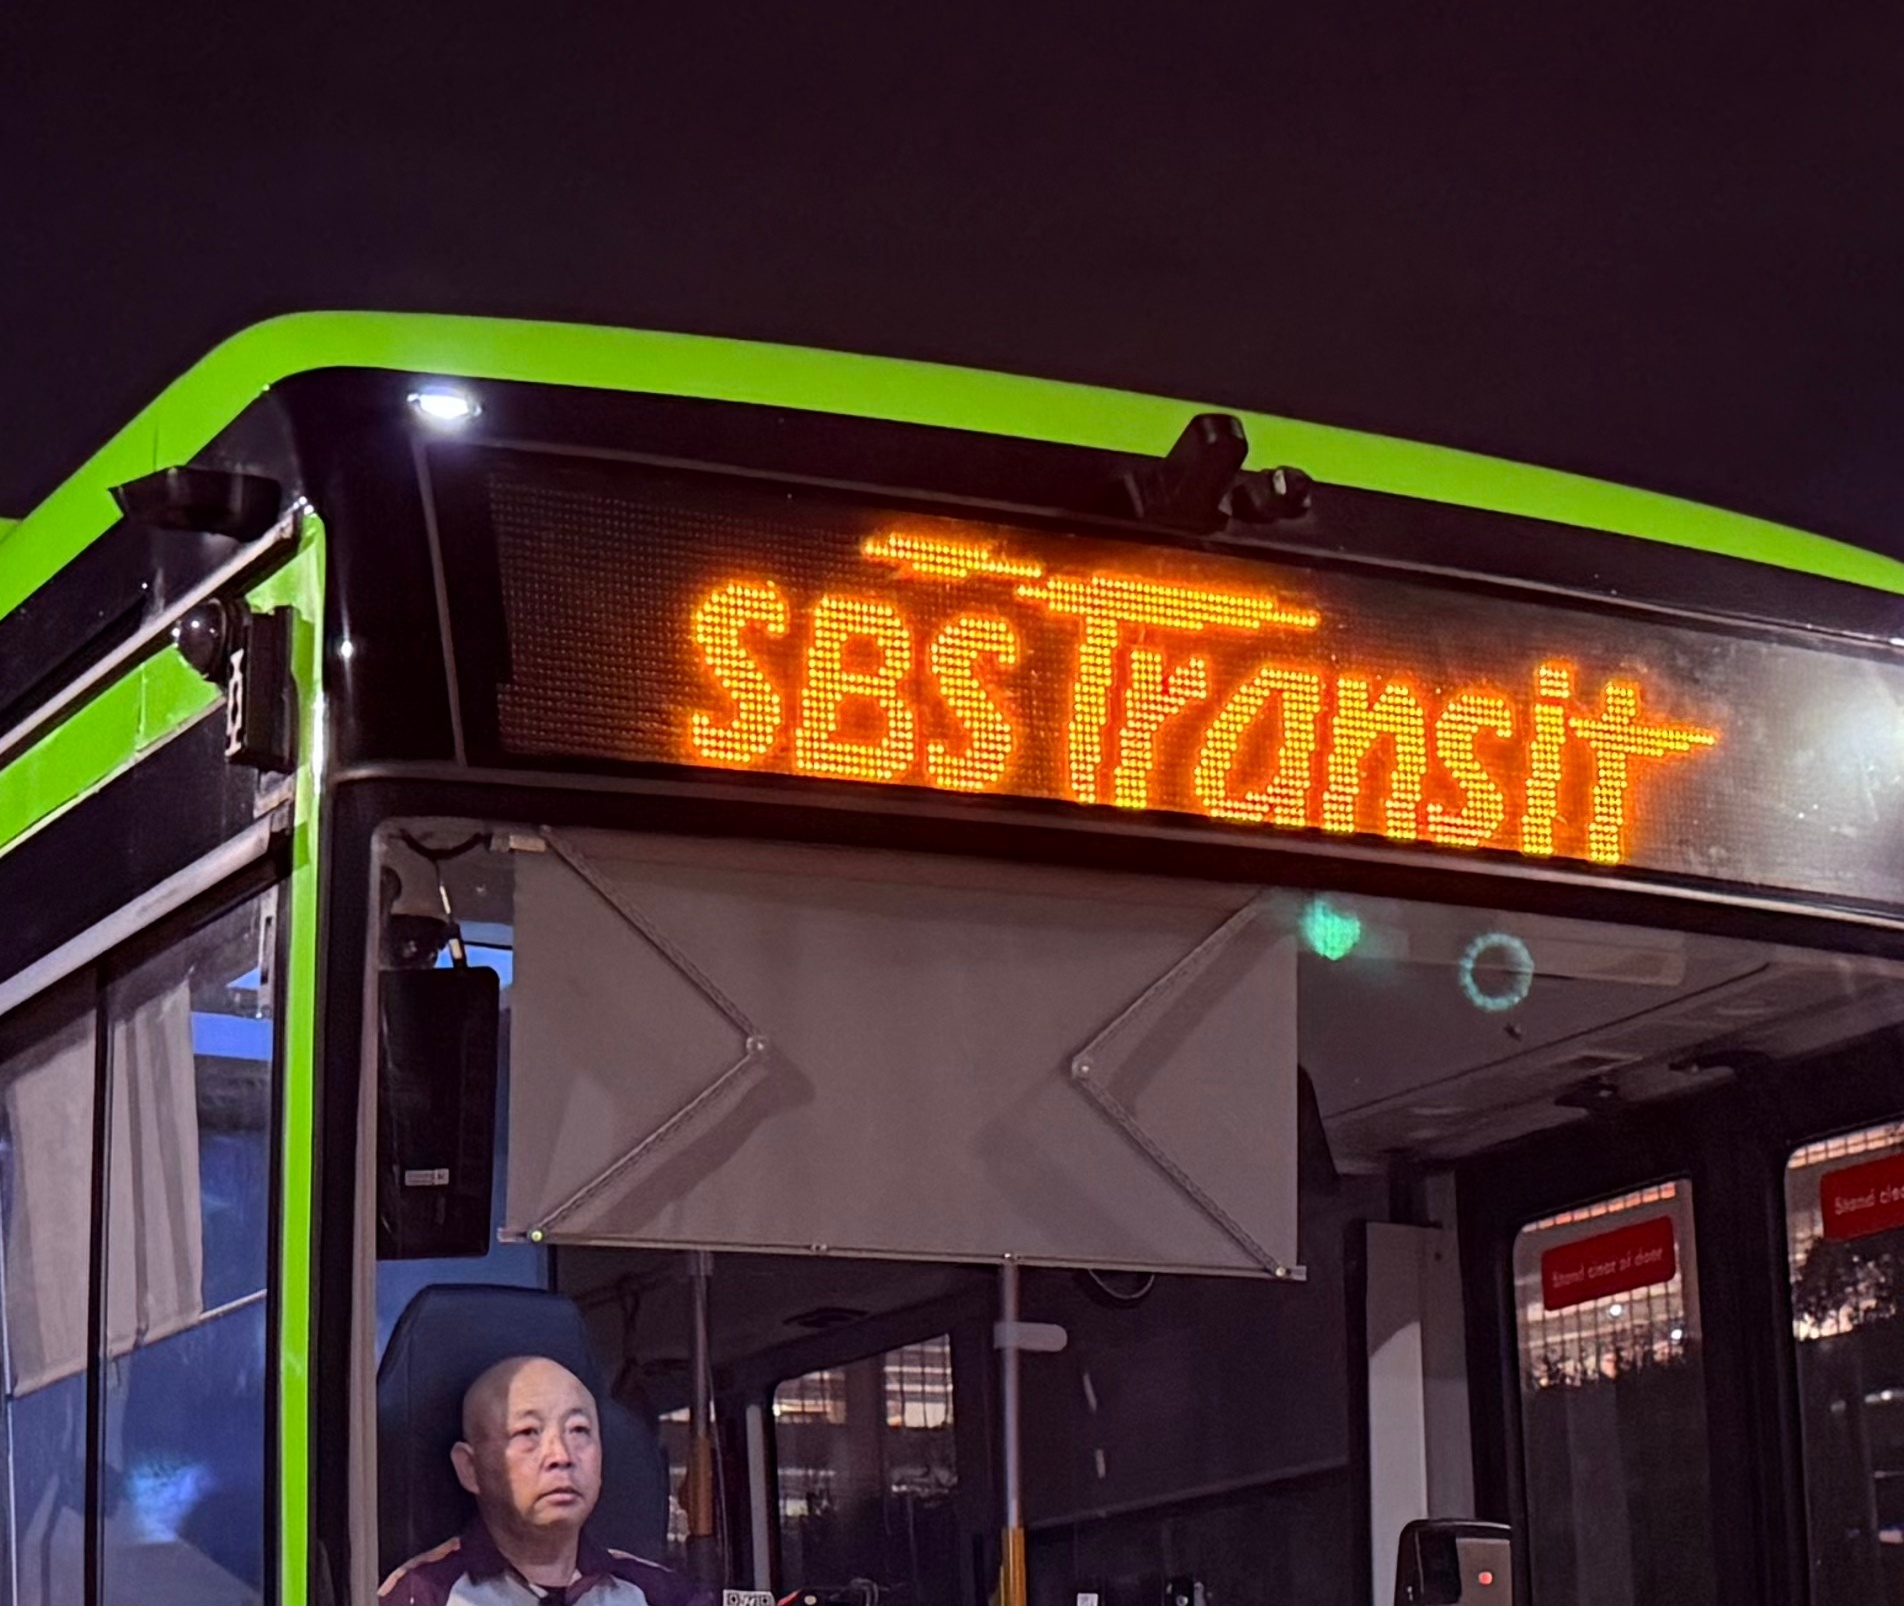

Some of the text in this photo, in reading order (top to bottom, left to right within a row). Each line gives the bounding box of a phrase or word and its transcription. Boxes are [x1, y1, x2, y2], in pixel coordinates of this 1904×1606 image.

[690, 570, 1720, 866] SBS Transit
[1834, 1188, 1876, 1216] Stand
